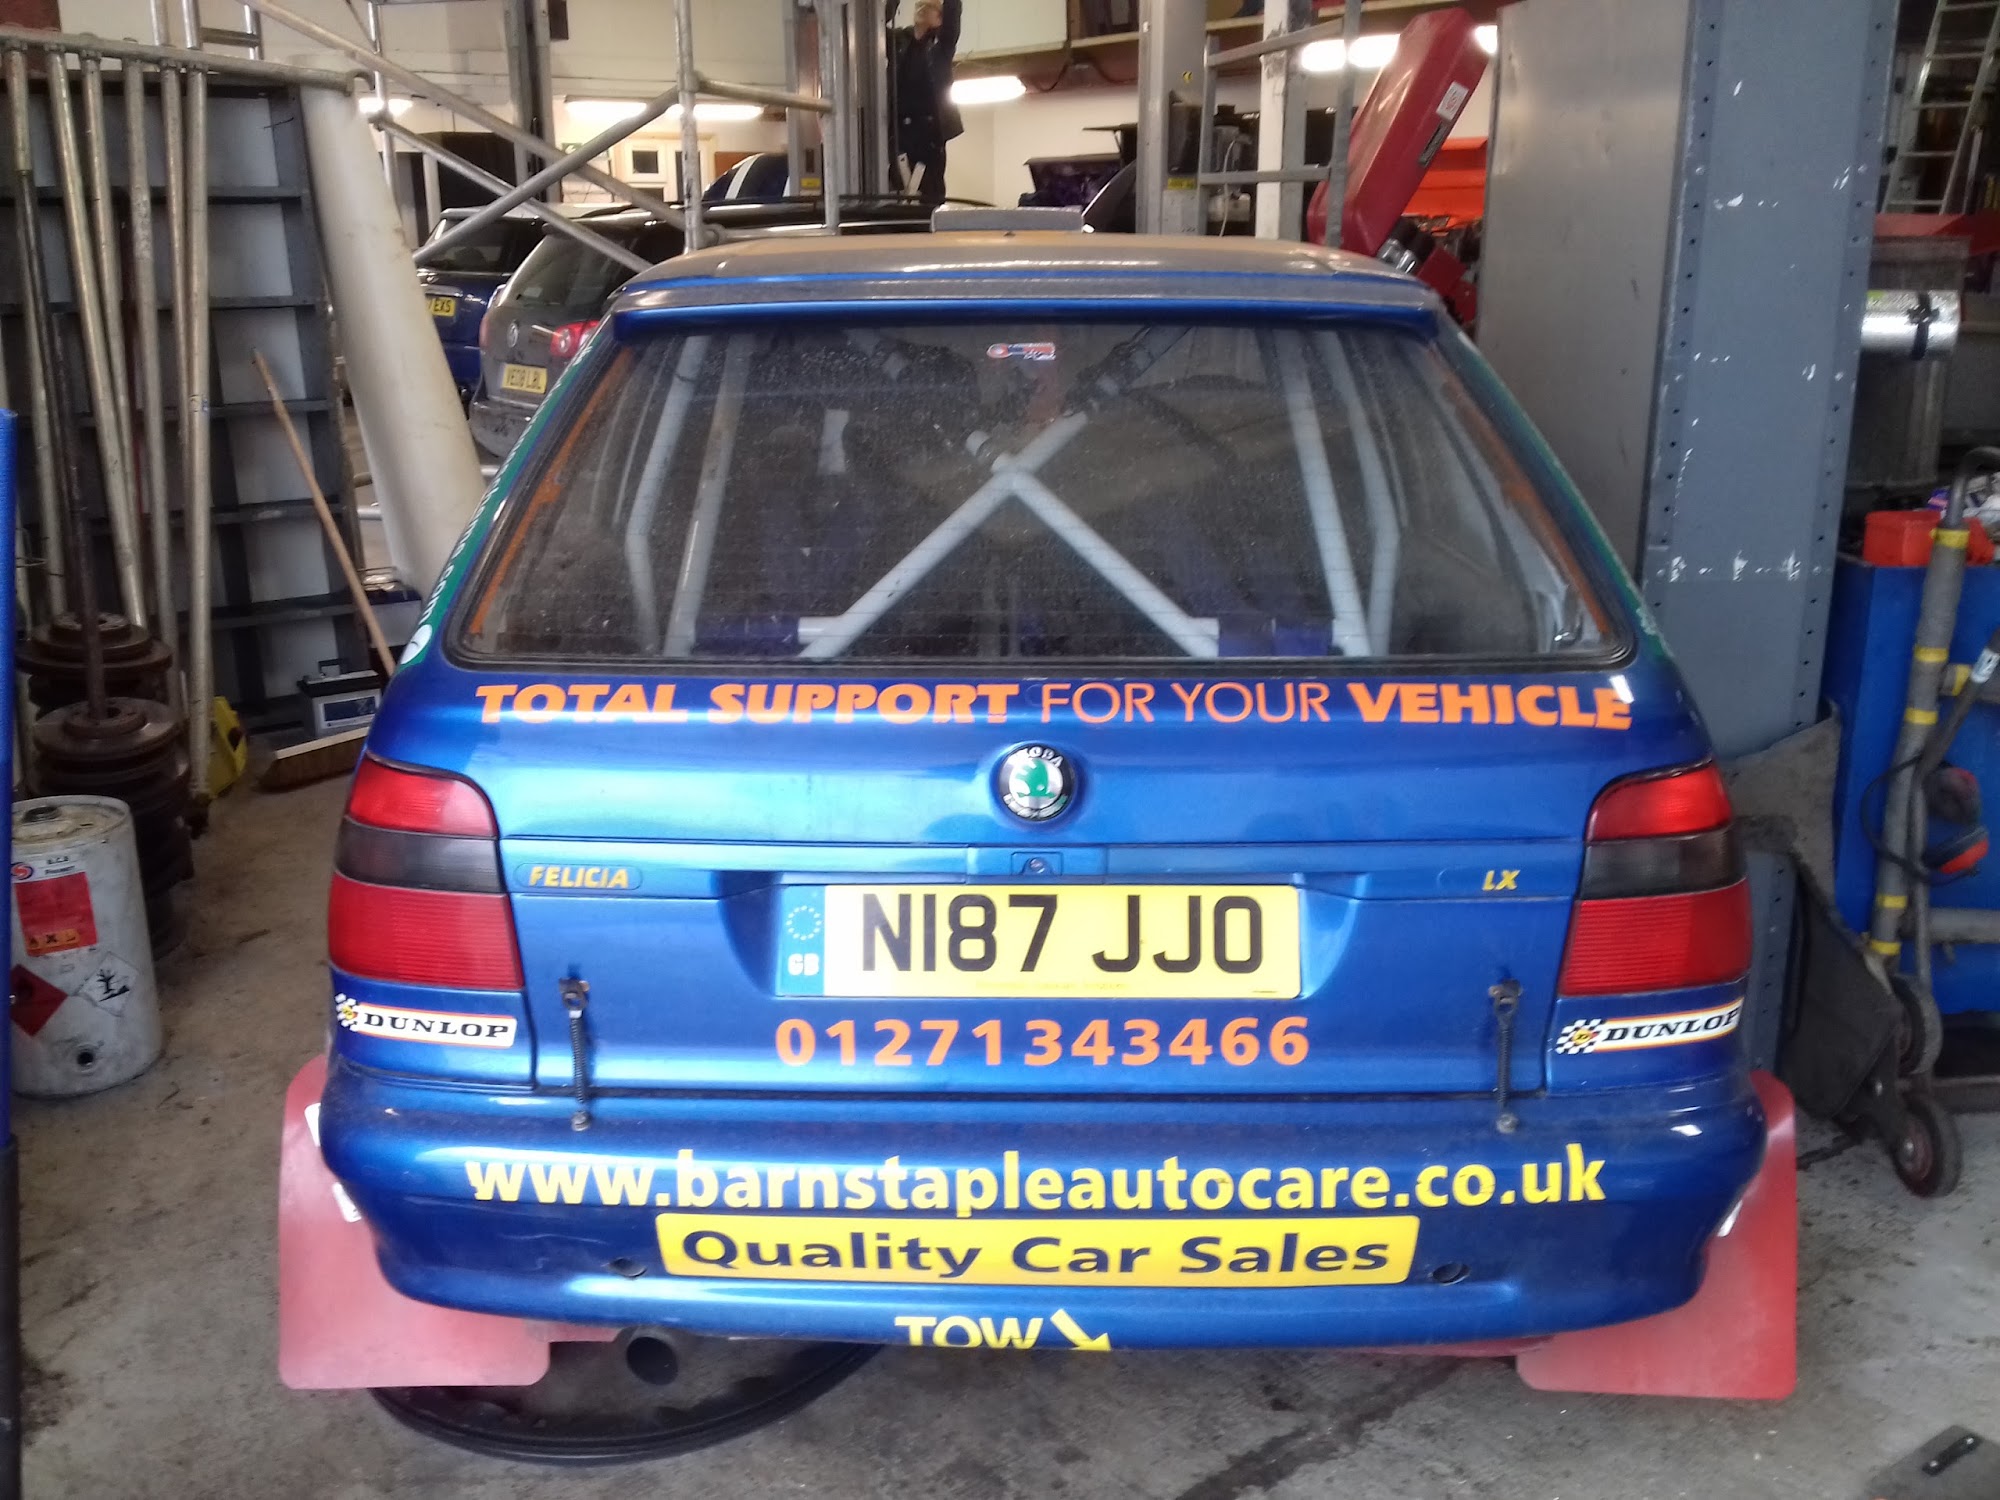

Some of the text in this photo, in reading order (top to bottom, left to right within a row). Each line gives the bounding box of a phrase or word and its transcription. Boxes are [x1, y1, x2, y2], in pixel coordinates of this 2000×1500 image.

[476, 683, 1633, 729] TOTAL SUPPORT FOR YOUR VEHICLE
[528, 866, 629, 888] FELICIA
[1482, 869, 1520, 891] LX
[788, 954, 819, 975] GB
[364, 1012, 508, 1038] DUNLOP
[1605, 1008, 1740, 1041] DUNLOP
[465, 1143, 1605, 1216] www.barnstapleautocare.co.uk
[683, 1230, 1390, 1278] Quality Car Sales
[894, 1316, 1044, 1349] TOW
